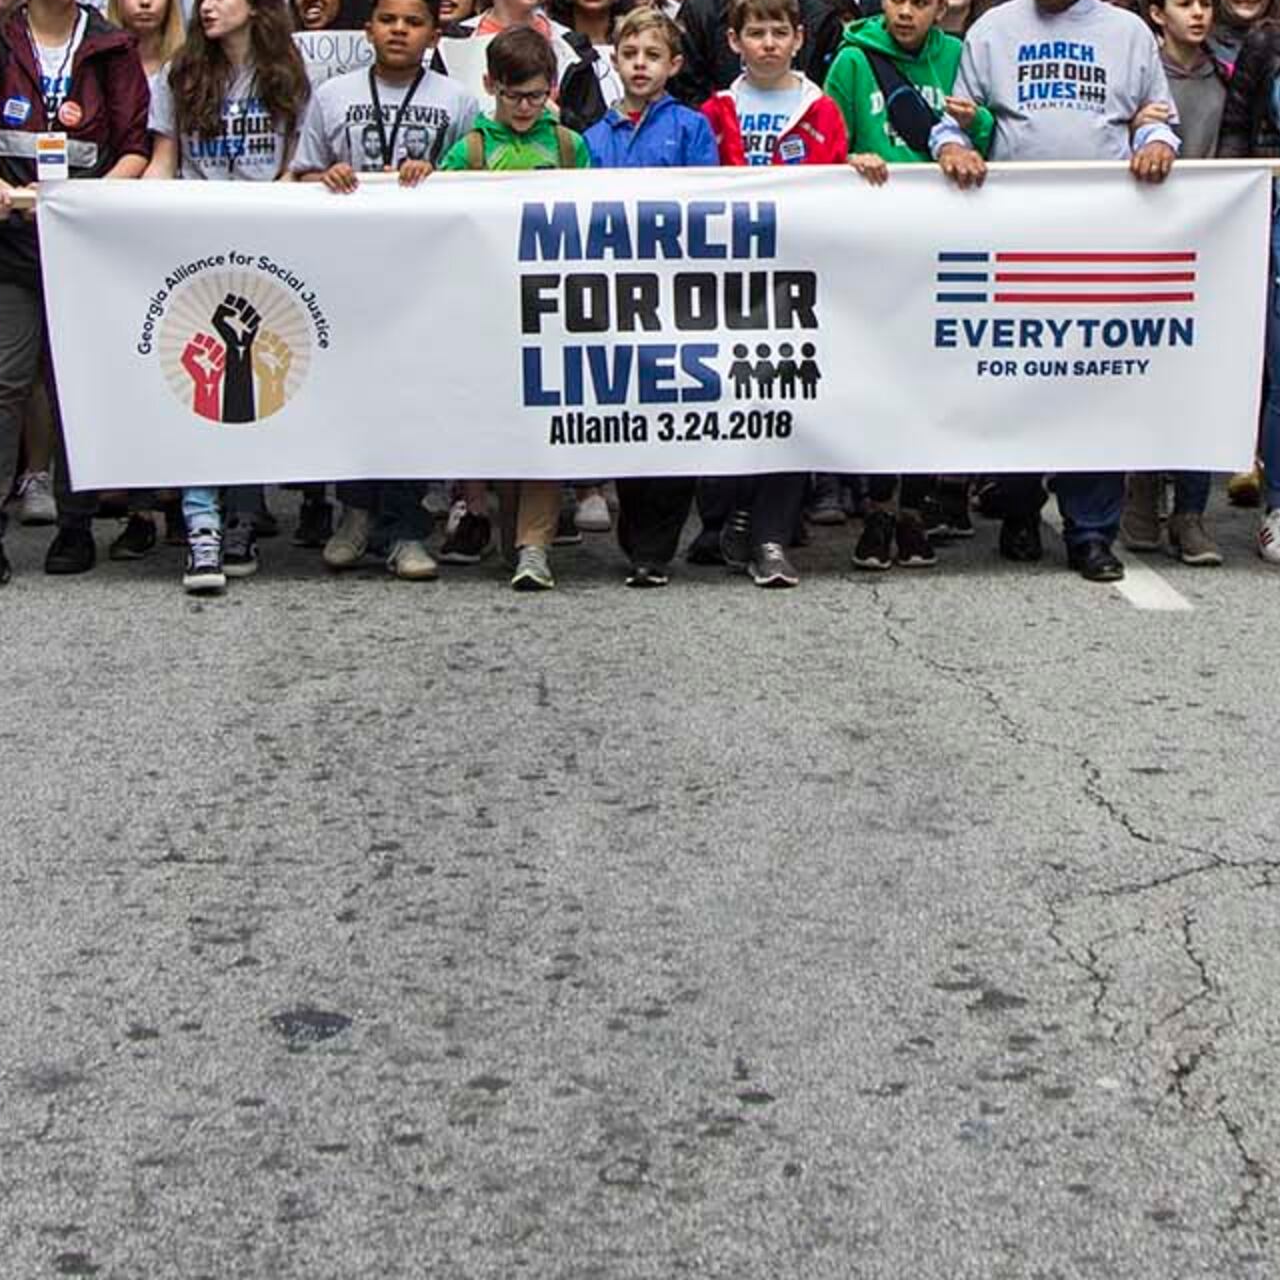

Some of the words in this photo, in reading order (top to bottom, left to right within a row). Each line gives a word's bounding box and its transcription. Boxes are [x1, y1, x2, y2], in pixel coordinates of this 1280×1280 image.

[293, 34, 373, 63] NOUG
[1018, 41, 1095, 61] MARCH
[1017, 64, 1061, 81] FOR
[1064, 65, 1106, 84] OUR
[1018, 82, 1076, 102] LIVES
[737, 111, 791, 132] ARC
[518, 201, 777, 261] MARCH
[137, 289, 169, 355] Georgia
[165, 254, 225, 291] Alliance
[229, 250, 255, 266] for
[258, 256, 305, 292] Social
[301, 291, 329, 349] Justice
[520, 273, 662, 334] FOR
[674, 271, 818, 331] OUR
[934, 317, 1194, 348] EVERYTOWN
[522, 343, 722, 407] LIVES
[977, 360, 1018, 377] FOR
[1024, 360, 1068, 377] GUN
[1073, 359, 1150, 376] SAFETY
[550, 411, 648, 445] Atlanta
[657, 410, 793, 442] 3.24.2018
